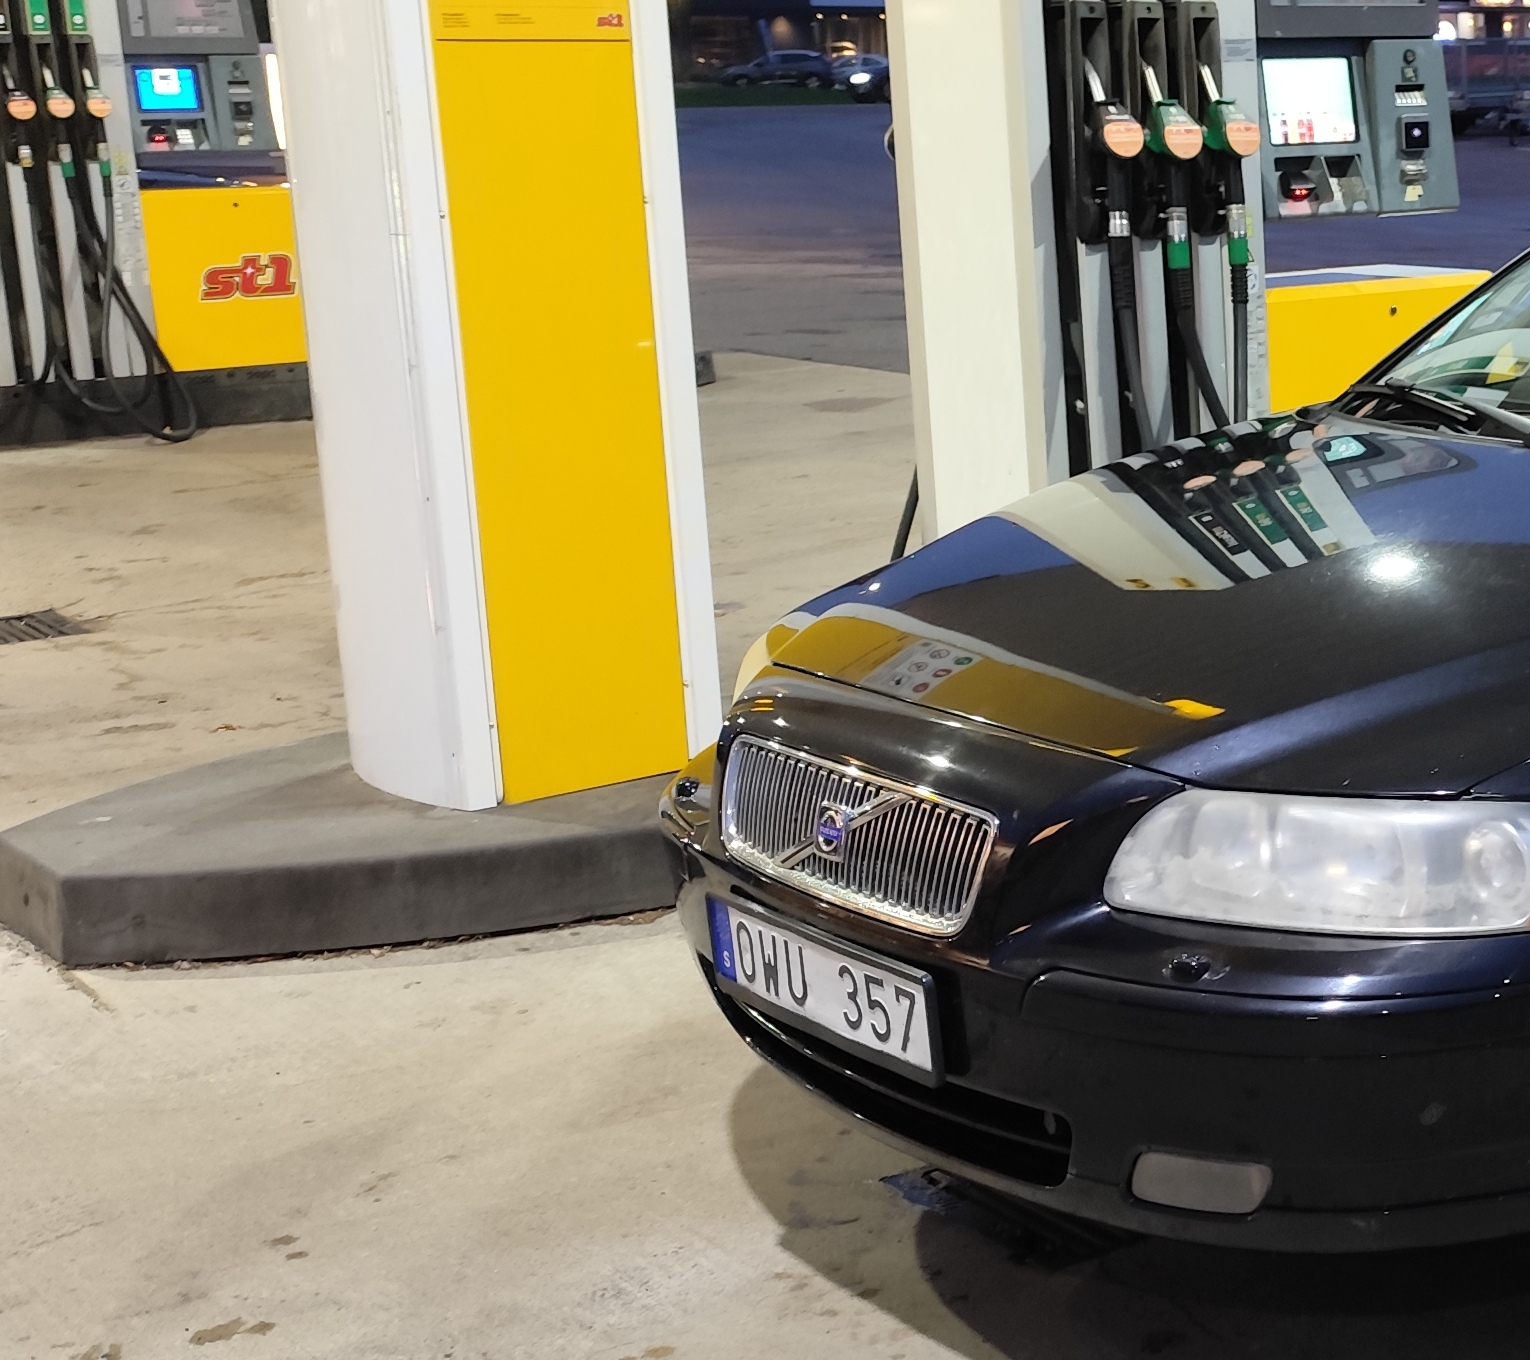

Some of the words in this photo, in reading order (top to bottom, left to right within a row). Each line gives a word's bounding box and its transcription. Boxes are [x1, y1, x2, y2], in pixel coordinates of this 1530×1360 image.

[722, 950, 732, 968] S
[736, 920, 809, 1007] OWU
[837, 963, 916, 1053] 357
